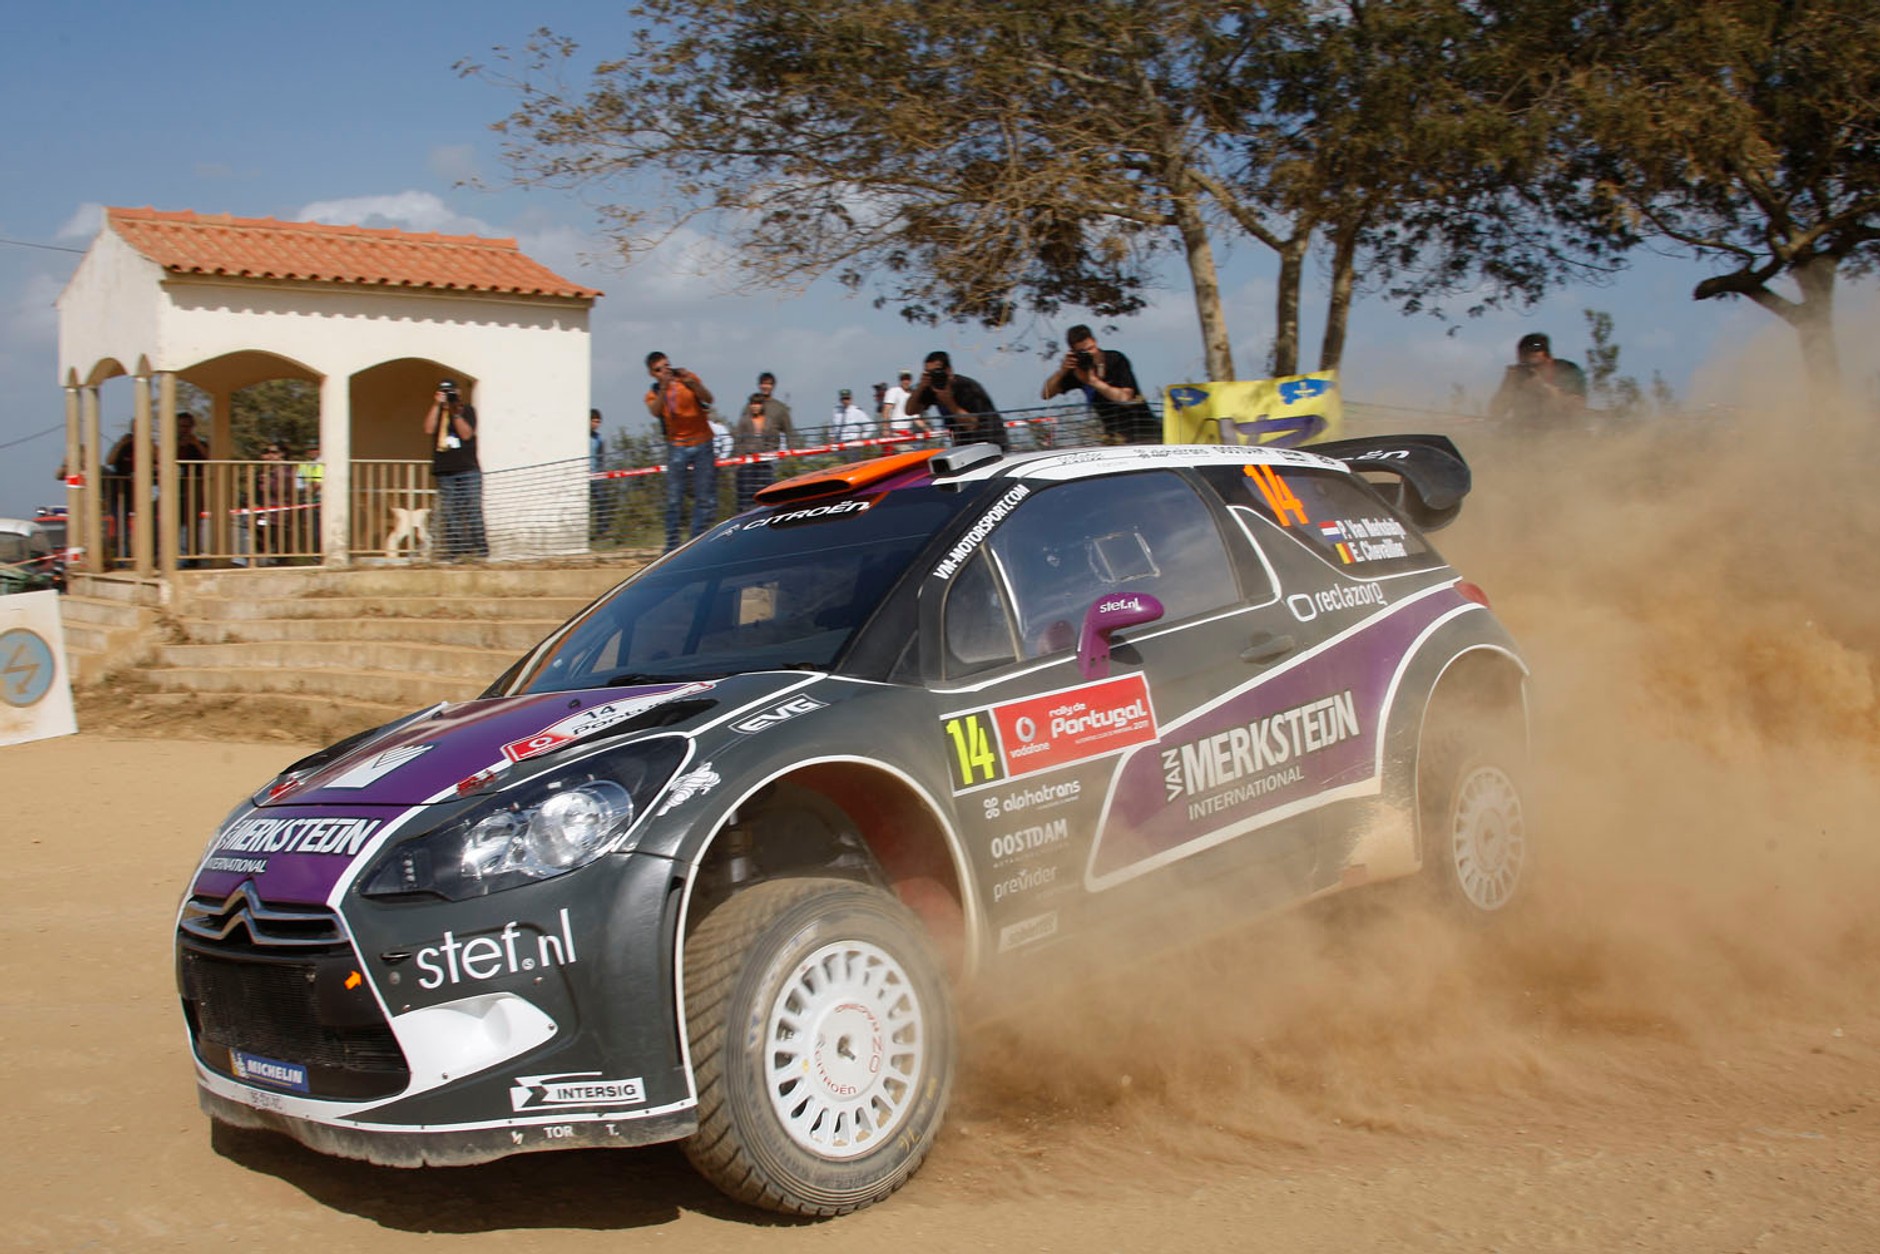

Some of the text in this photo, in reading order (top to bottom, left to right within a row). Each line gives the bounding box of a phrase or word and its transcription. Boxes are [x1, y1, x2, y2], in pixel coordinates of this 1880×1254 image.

[1243, 464, 1310, 527] 14
[933, 483, 1031, 581] VM-MOTORSPORT.COM
[1099, 597, 1139, 614] stef.nl
[1315, 583, 1388, 613] reclazorg
[583, 705, 616, 719] 14
[740, 697, 821, 731] EVG
[1051, 699, 1149, 739] Portugal
[945, 714, 996, 786] 14
[1009, 740, 1051, 759] vodafone
[1161, 748, 1184, 802] VAN
[1003, 780, 1082, 813] alphatrans
[1188, 765, 1305, 821] INTERNATIONAL
[991, 818, 1069, 859] OOSTDAM
[993, 865, 1058, 902] previder
[416, 908, 577, 989] stef.nl
[246, 1059, 304, 1085] MICHELIN
[557, 1084, 637, 1100] INTERSIG
[543, 1125, 576, 1140] TOR
